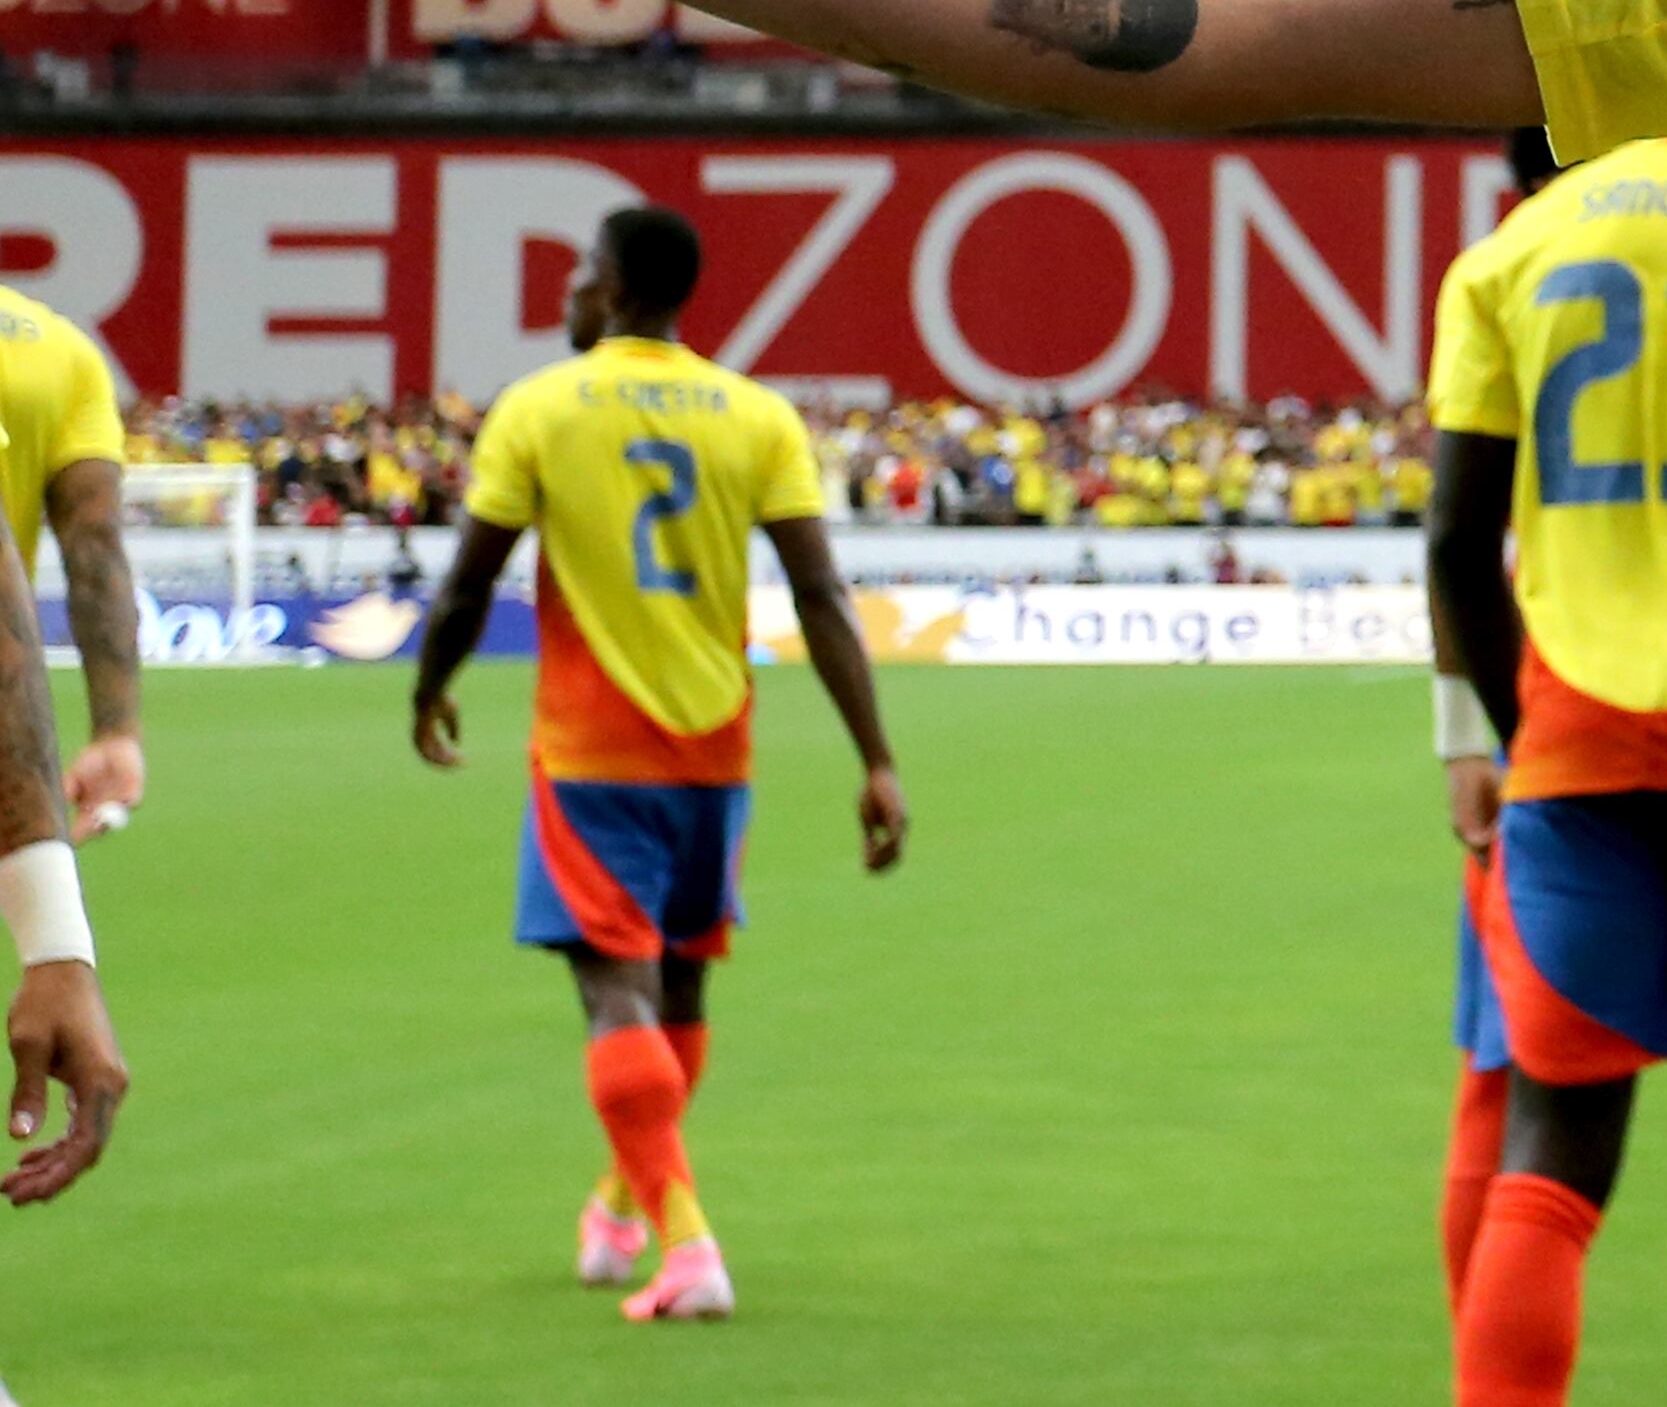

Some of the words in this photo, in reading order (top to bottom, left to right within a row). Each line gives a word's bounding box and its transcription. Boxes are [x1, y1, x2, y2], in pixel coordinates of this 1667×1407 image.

[625, 439, 697, 597] 2
[955, 587, 1262, 662] Change
[1297, 587, 1432, 649] Bea
